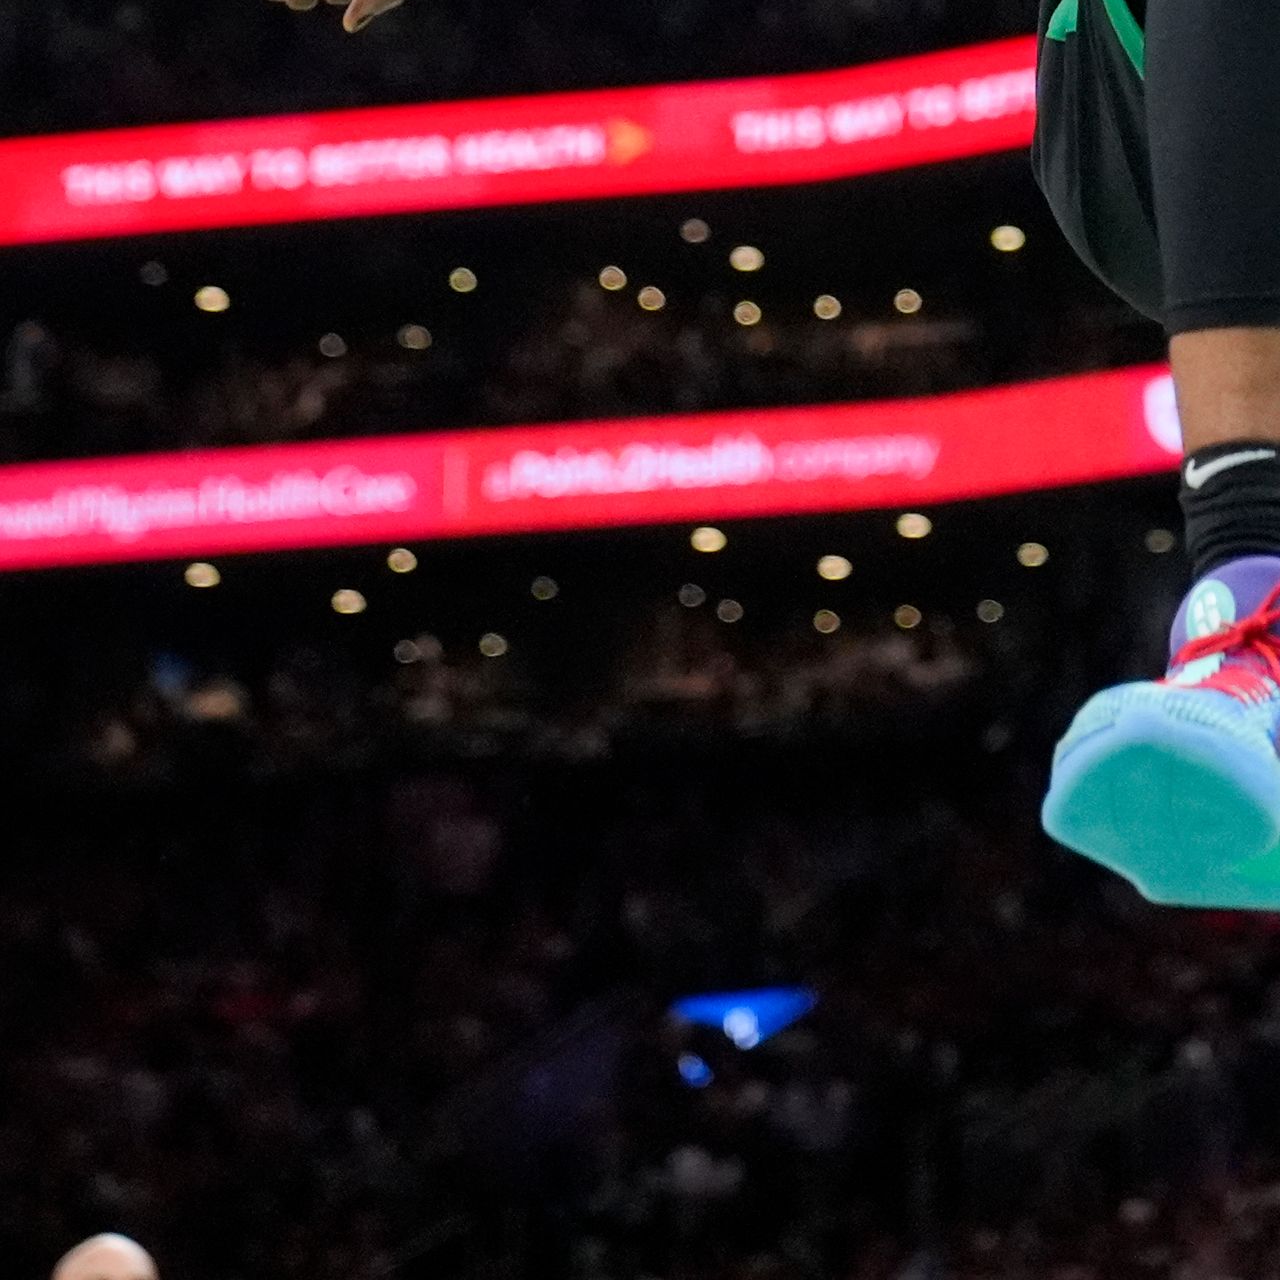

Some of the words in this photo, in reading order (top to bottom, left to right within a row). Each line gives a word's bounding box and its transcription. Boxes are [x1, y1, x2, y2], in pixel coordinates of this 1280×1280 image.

[158, 152, 243, 199] WAY
[249, 147, 305, 191] TO
[307, 134, 450, 188] BETTER
